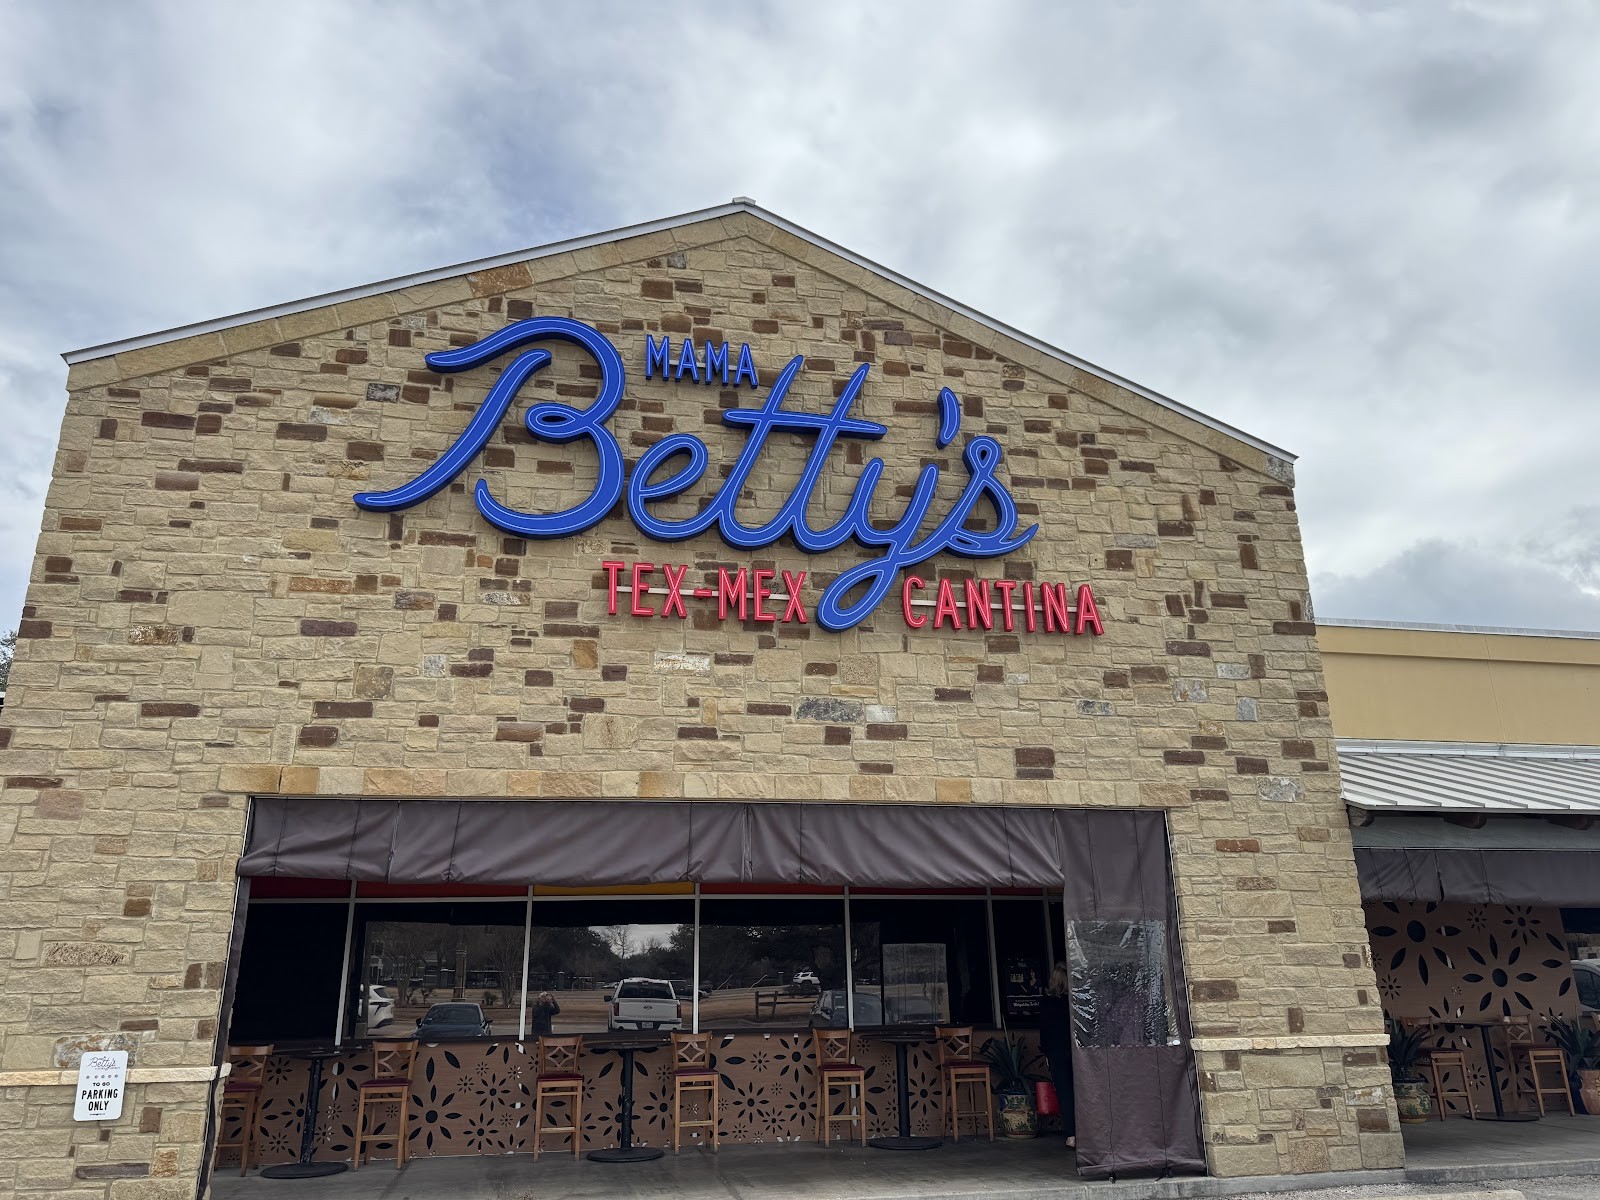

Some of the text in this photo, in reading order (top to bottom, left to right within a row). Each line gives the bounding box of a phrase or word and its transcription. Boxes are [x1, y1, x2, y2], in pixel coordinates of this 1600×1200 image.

[646, 334, 759, 387] MAMA
[353, 317, 1039, 631] Betty's
[602, 561, 1105, 636] TEX-MEX CANTINA
[81, 1088, 119, 1100] PARKING
[88, 1100, 109, 1111] ONLY
